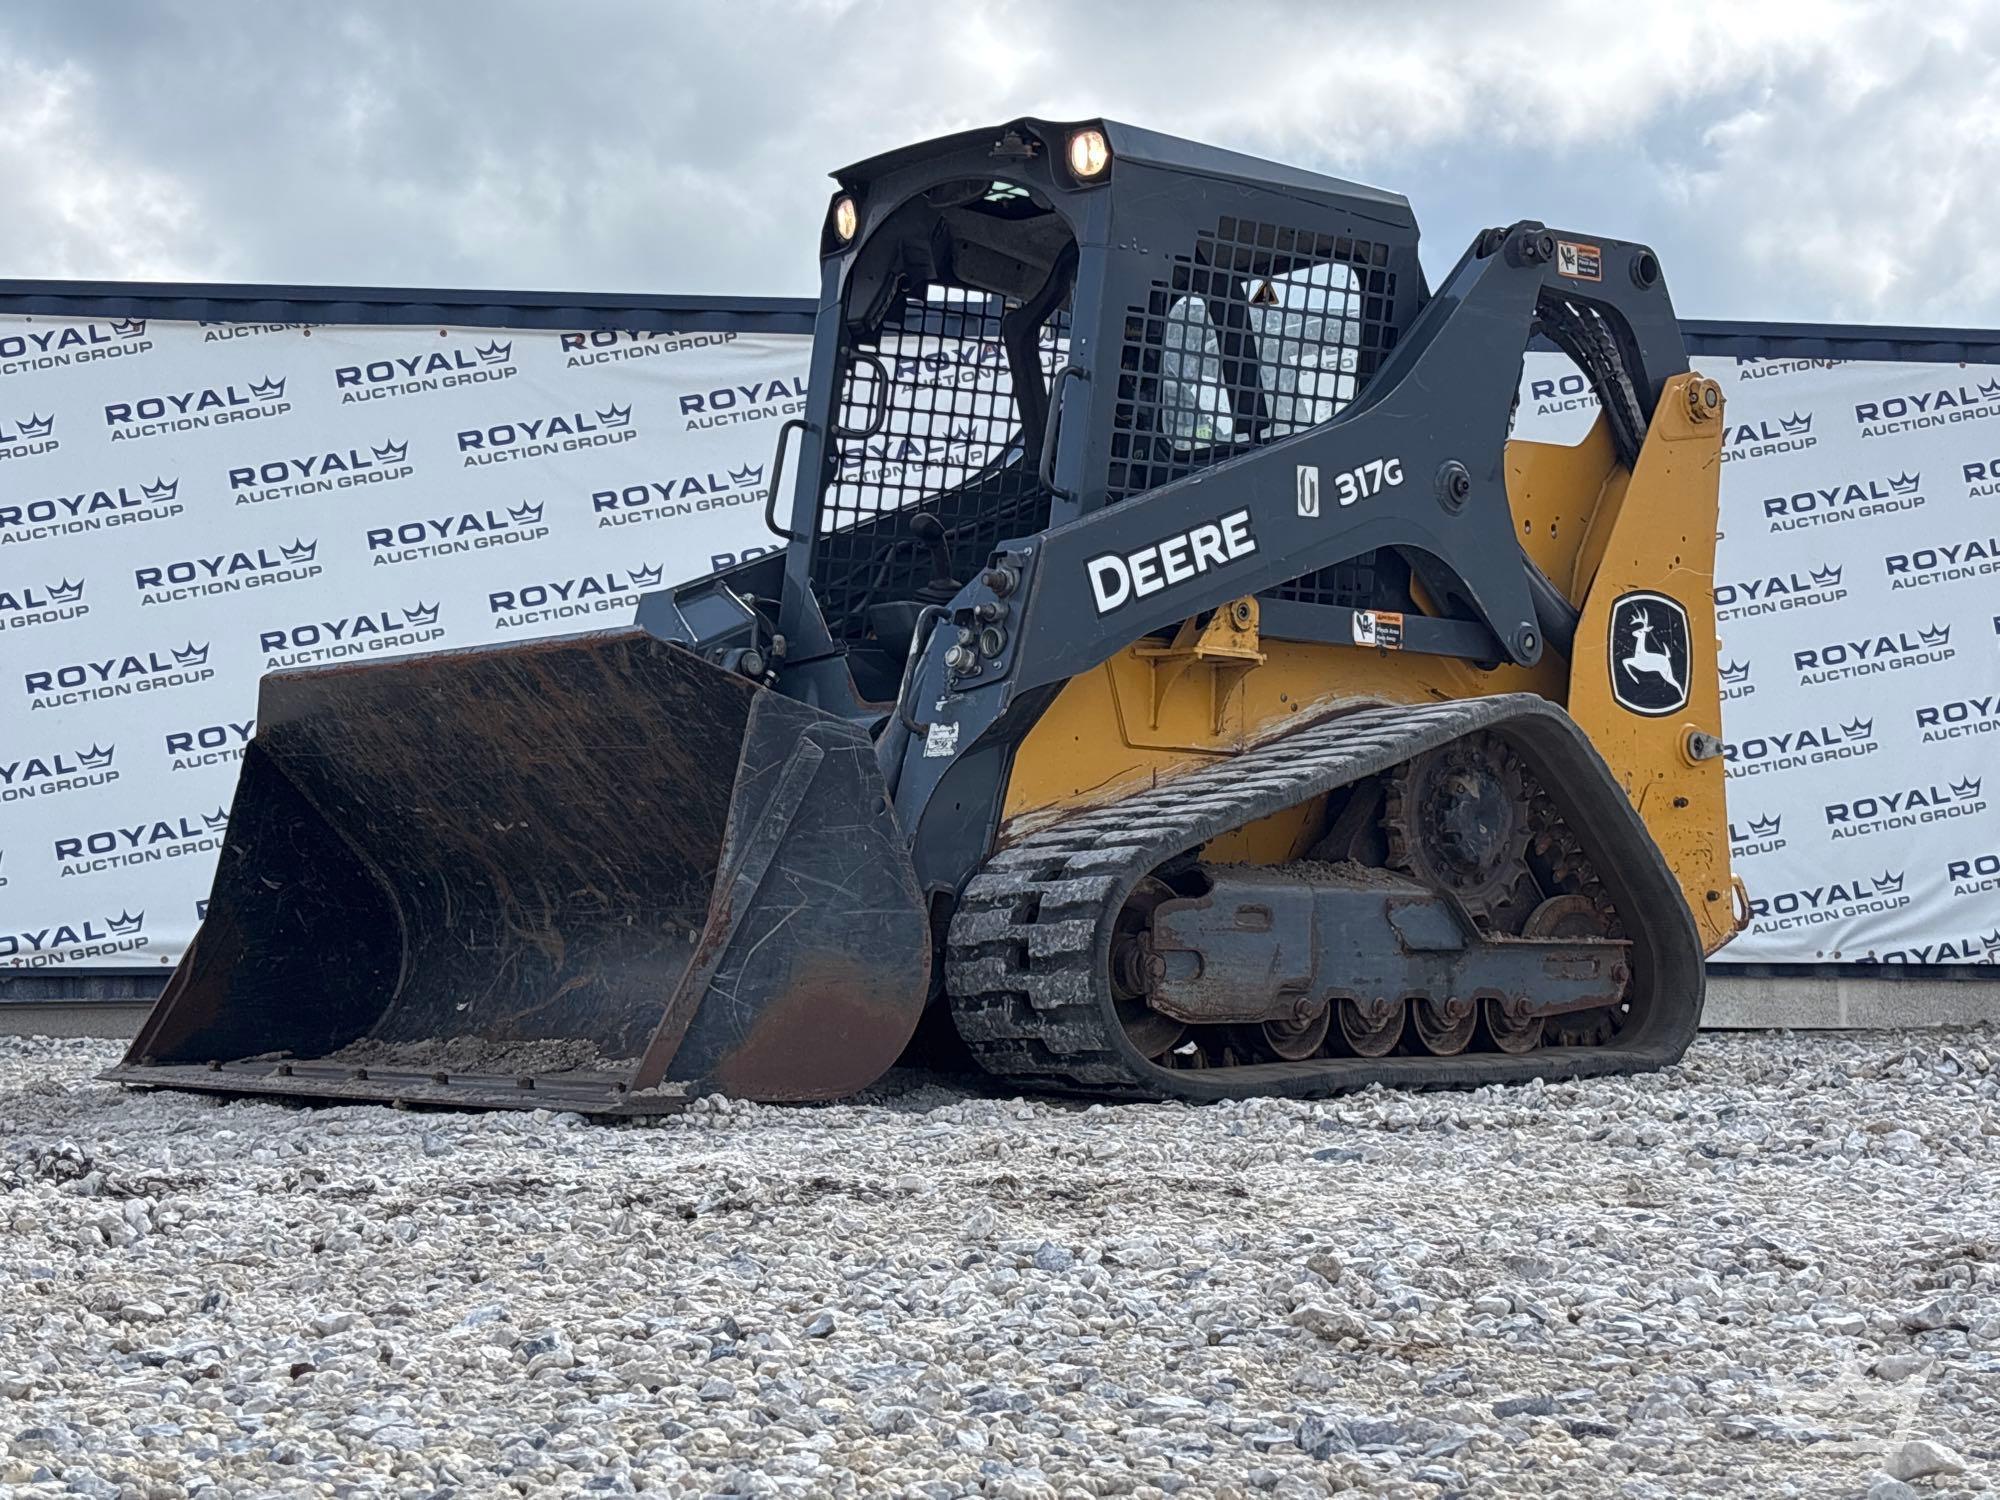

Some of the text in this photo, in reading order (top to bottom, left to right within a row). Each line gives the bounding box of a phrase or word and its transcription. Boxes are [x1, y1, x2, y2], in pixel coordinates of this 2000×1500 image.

[0, 325, 111, 358] OYAL
[3, 341, 153, 374] CTION GROUP
[567, 332, 738, 368] AUCTION GROUP
[335, 350, 477, 388] ROYAL
[342, 367, 517, 404] AUCTION GROUP
[1740, 358, 1825, 381] AUCTION
[105, 386, 250, 425] ROYAL
[680, 377, 807, 416] ROYAL
[1537, 395, 1601, 416] AUCTI
[1855, 387, 1979, 423] ROYAL
[111, 403, 291, 442] AUCTION GROUP
[457, 413, 597, 452] ROYAL
[686, 406, 778, 431] AUCTION
[1862, 405, 2000, 438] AUCTION GROU
[0, 440, 59, 460] ROUP
[464, 430, 637, 467] AUCTION GROUP
[1750, 437, 1817, 457] GROUP
[229, 450, 373, 489] ROYAL
[235, 466, 413, 505] AUCTION GROUP
[1335, 458, 1404, 505] 317G
[0, 488, 142, 528] ROYAL
[592, 474, 730, 512] ROYAL
[599, 490, 768, 528] AUCTION GROUP
[1764, 481, 1889, 518] ROYAL
[1, 504, 184, 545] AUCTION GROUP
[367, 511, 509, 550] ROYAL
[1770, 497, 1925, 533] AUCTION GROUP
[373, 527, 549, 566] AUCTION GROUP
[1087, 510, 1256, 613] DEERE
[135, 549, 281, 590] ROYAL
[141, 566, 322, 606] AUCTION GROUP
[1892, 566, 1975, 590] AUCTION
[489, 573, 629, 613] ROYAL
[1714, 574, 1811, 605] OYAL
[1717, 589, 1847, 621] CTION GROUP
[10, 605, 89, 628] GROUP
[495, 594, 639, 629] AUCTION GRO
[260, 612, 404, 653] ROYAL
[266, 628, 445, 669] AUCTION GROUP
[1794, 633, 1920, 671] ROYAL
[1800, 649, 1955, 686] AUCTION GROUP
[25, 652, 172, 694] ROYAL
[31, 669, 214, 710] AUCTION GROUP
[1916, 696, 2000, 728] ROY
[166, 720, 256, 755] ROY
[1723, 727, 1842, 762] ROYAL
[0, 755, 77, 785] YAL
[172, 748, 246, 771] AUCTI
[1724, 742, 1878, 779] AUCTION GROUP
[40, 771, 119, 795] GROUP
[1825, 786, 1951, 824] ROYAL
[1831, 802, 1986, 840] AUCTION GROUP
[55, 818, 203, 861] ROYAL
[1732, 839, 1786, 858] ROUP
[61, 848, 161, 877] AUCTION
[1750, 881, 1873, 920] ROYAL
[1752, 896, 1910, 935] AUCTION GROUP
[0, 921, 106, 957] OYAL
[70, 936, 148, 960] GROUP
